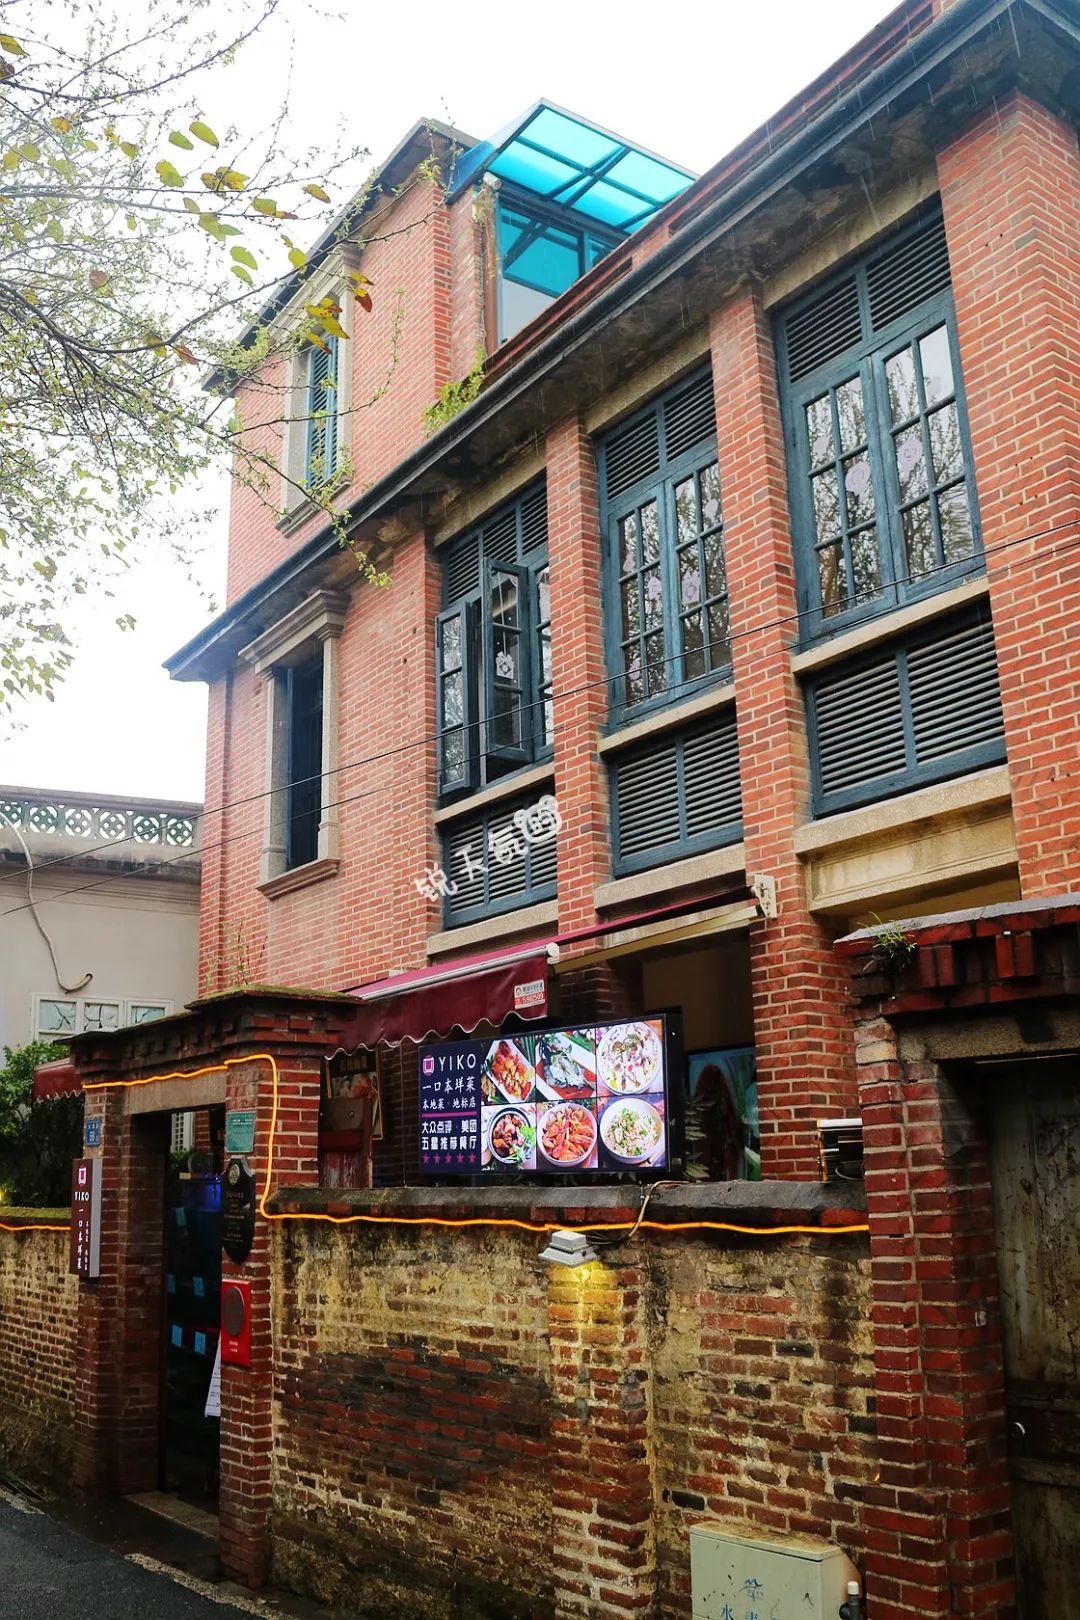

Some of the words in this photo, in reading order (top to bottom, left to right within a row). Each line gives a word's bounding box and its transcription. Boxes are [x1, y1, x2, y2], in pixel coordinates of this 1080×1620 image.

[438, 1053, 477, 1072] YIKO
[421, 1120, 452, 1134] 大众点评
[461, 1119, 477, 1133] 美团
[421, 1135, 477, 1150] 五星推荐餐厅
